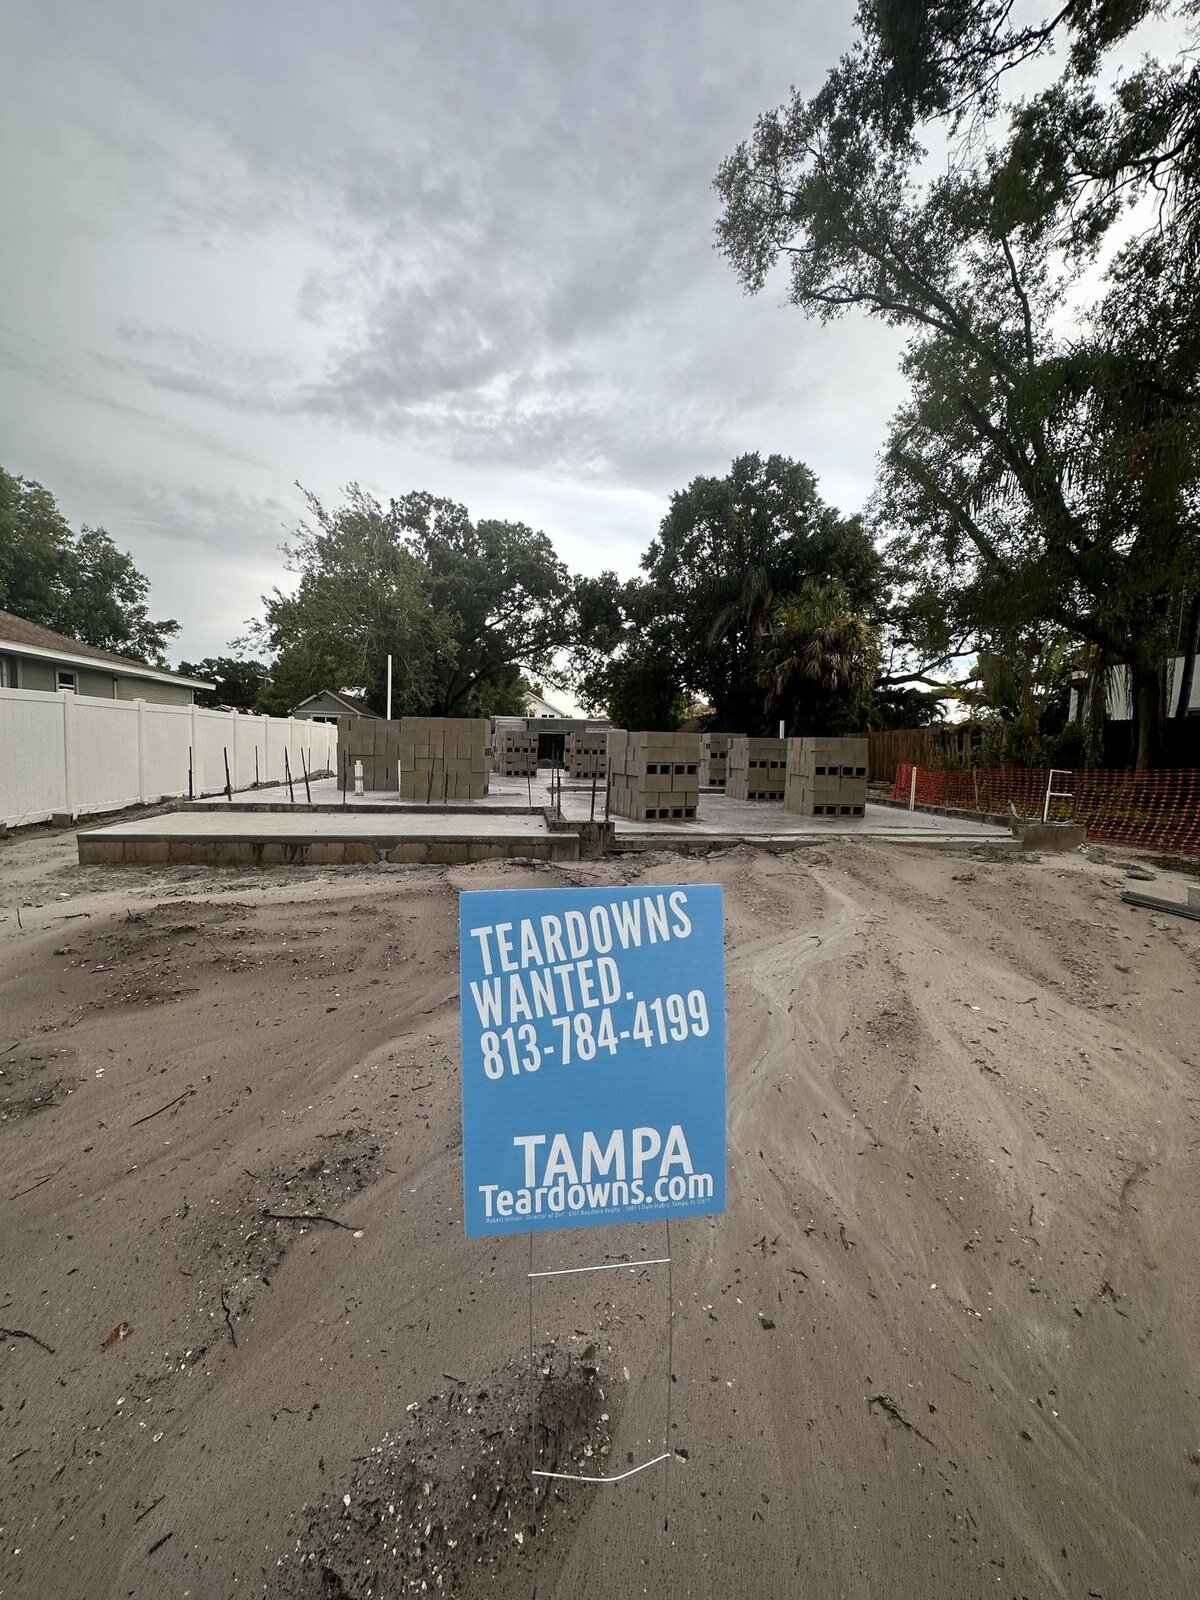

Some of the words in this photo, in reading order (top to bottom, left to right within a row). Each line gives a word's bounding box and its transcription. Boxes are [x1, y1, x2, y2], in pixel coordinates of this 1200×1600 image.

[470, 891, 692, 975] TEARDOWNS
[469, 956, 634, 1029] WANTED.
[480, 989, 710, 1080] 813-784-4199
[513, 1125, 694, 1188] TAMPA
[478, 1173, 714, 1217] Teardowns.com
